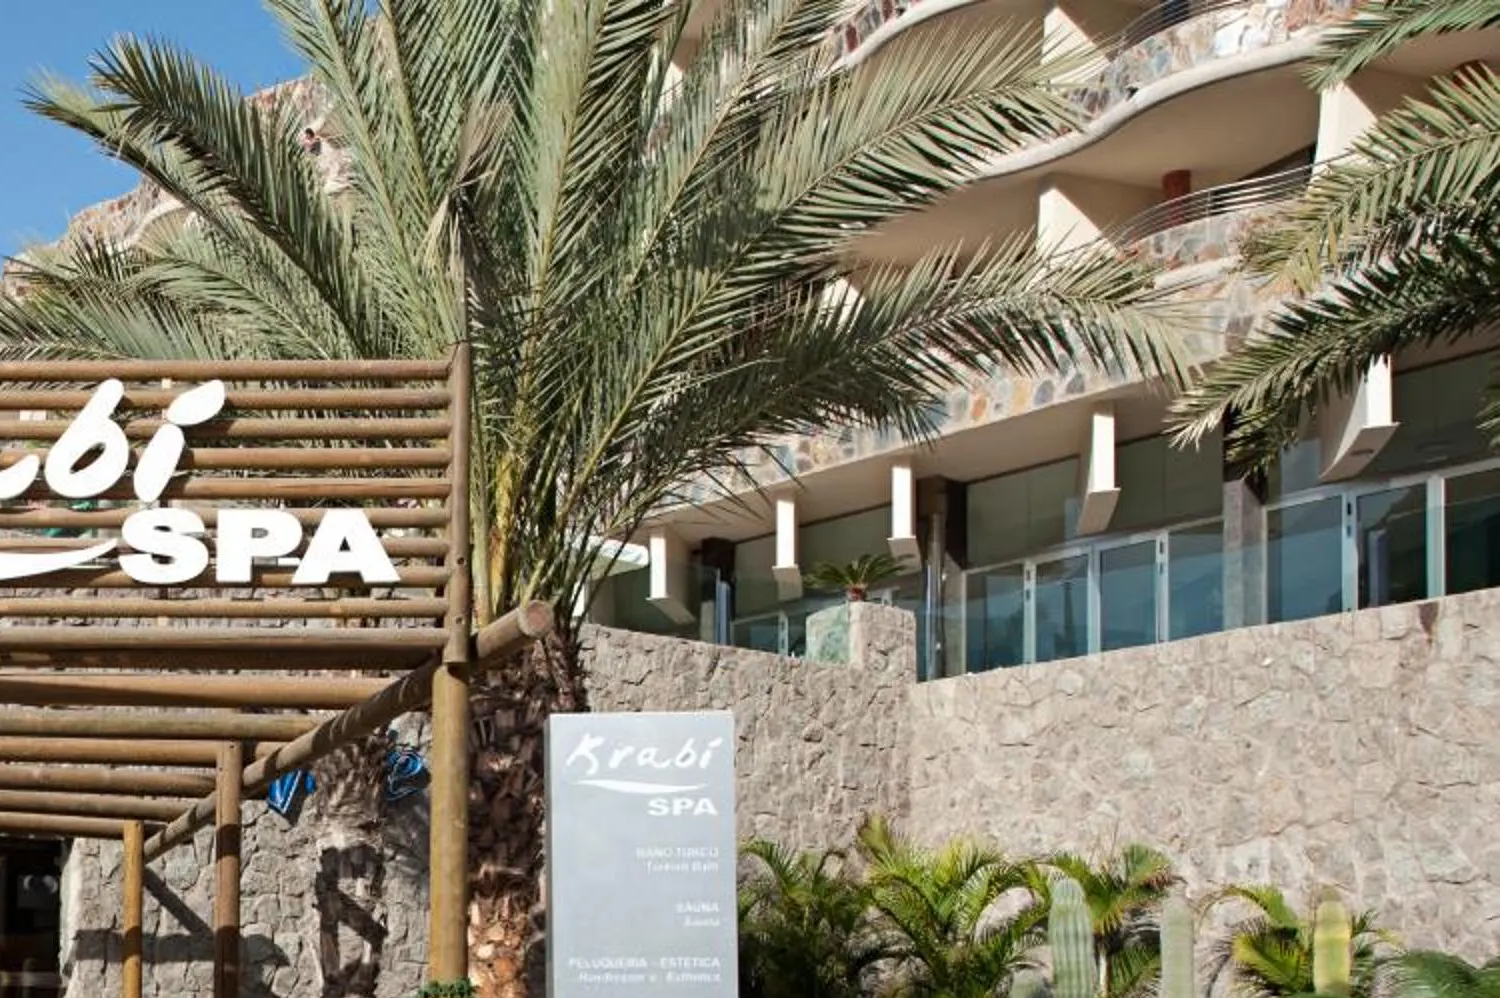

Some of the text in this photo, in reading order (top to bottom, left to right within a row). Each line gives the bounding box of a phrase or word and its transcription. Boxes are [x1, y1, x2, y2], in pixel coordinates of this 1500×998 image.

[118, 507, 401, 584] SPA
[564, 731, 722, 776] Krabi
[647, 797, 719, 817] SPA
